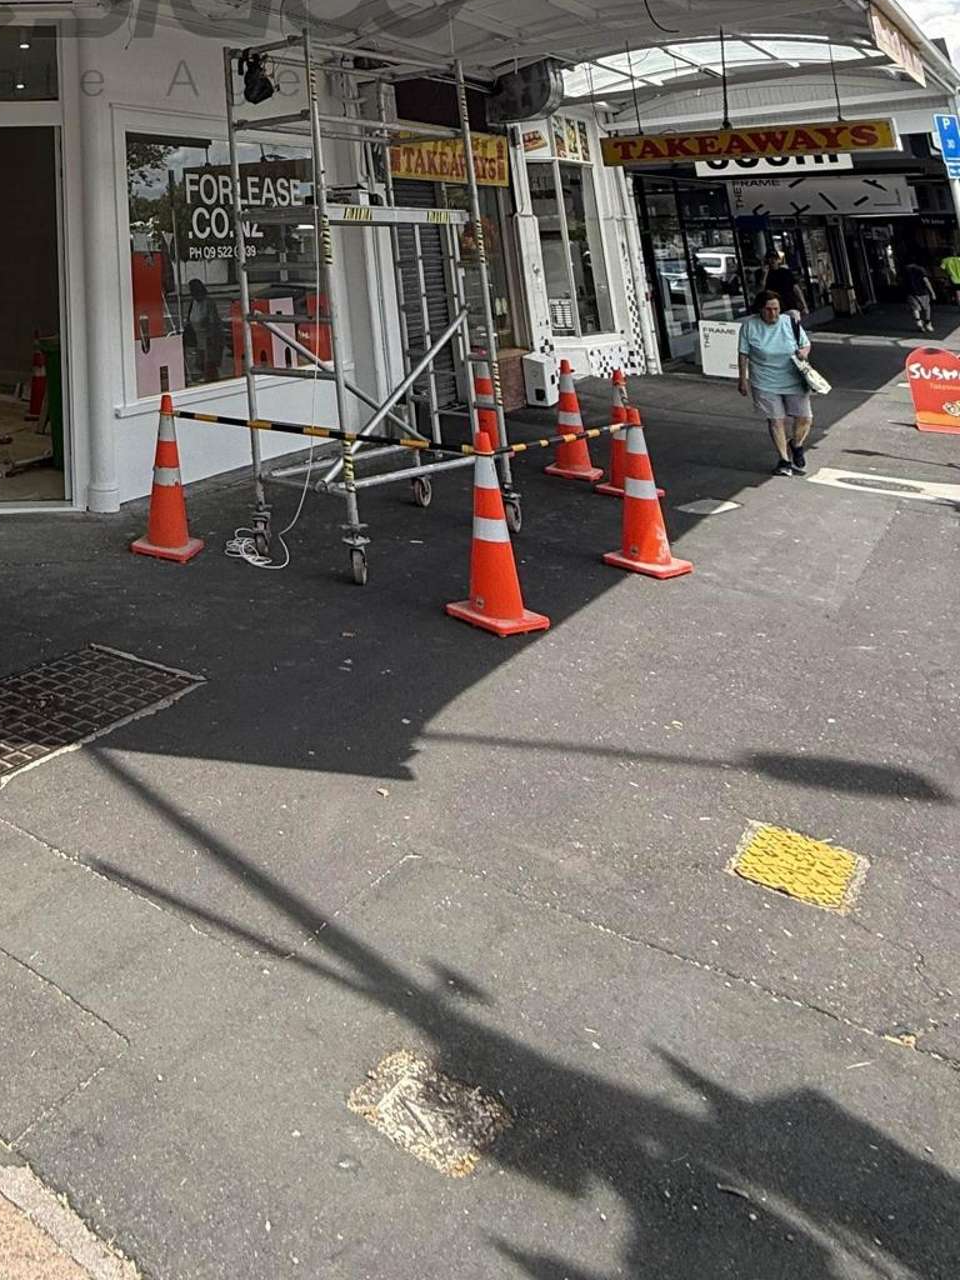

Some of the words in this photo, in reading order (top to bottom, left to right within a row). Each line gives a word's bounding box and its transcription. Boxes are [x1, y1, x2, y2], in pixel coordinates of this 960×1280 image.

[942, 117, 951, 130] P
[613, 124, 879, 161] TAKEAWAYS
[189, 246, 201, 259] PH
[203, 246, 216, 258] 09
[218, 246, 233, 258] 522
[234, 244, 257, 258] 039
